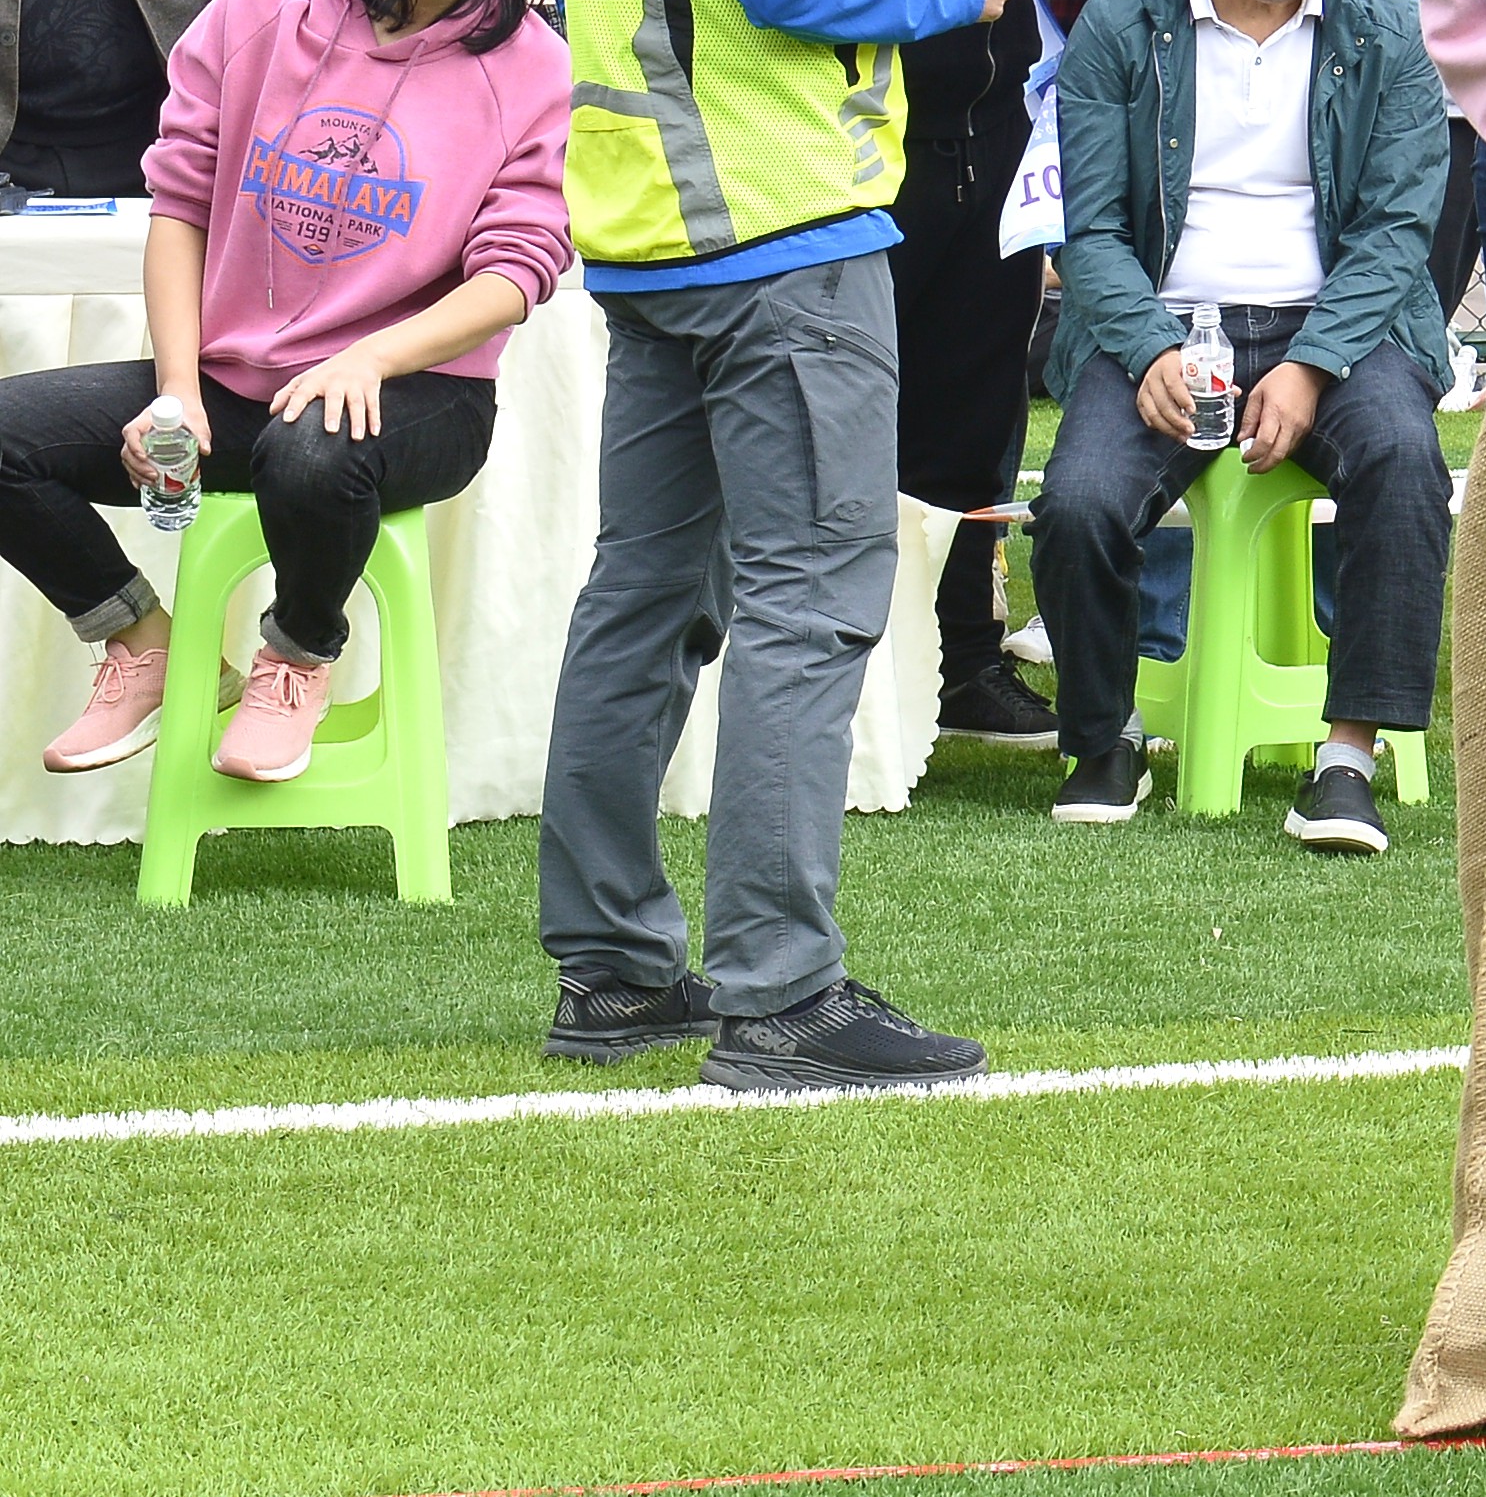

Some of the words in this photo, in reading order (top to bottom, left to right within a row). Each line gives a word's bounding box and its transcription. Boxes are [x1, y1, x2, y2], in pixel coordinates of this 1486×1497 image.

[320, 117, 382, 142] MOUNTAN
[249, 147, 412, 223] HIMALAYA
[264, 197, 344, 229] NATIONA
[348, 219, 385, 239] PARK
[296, 221, 342, 244] 199
